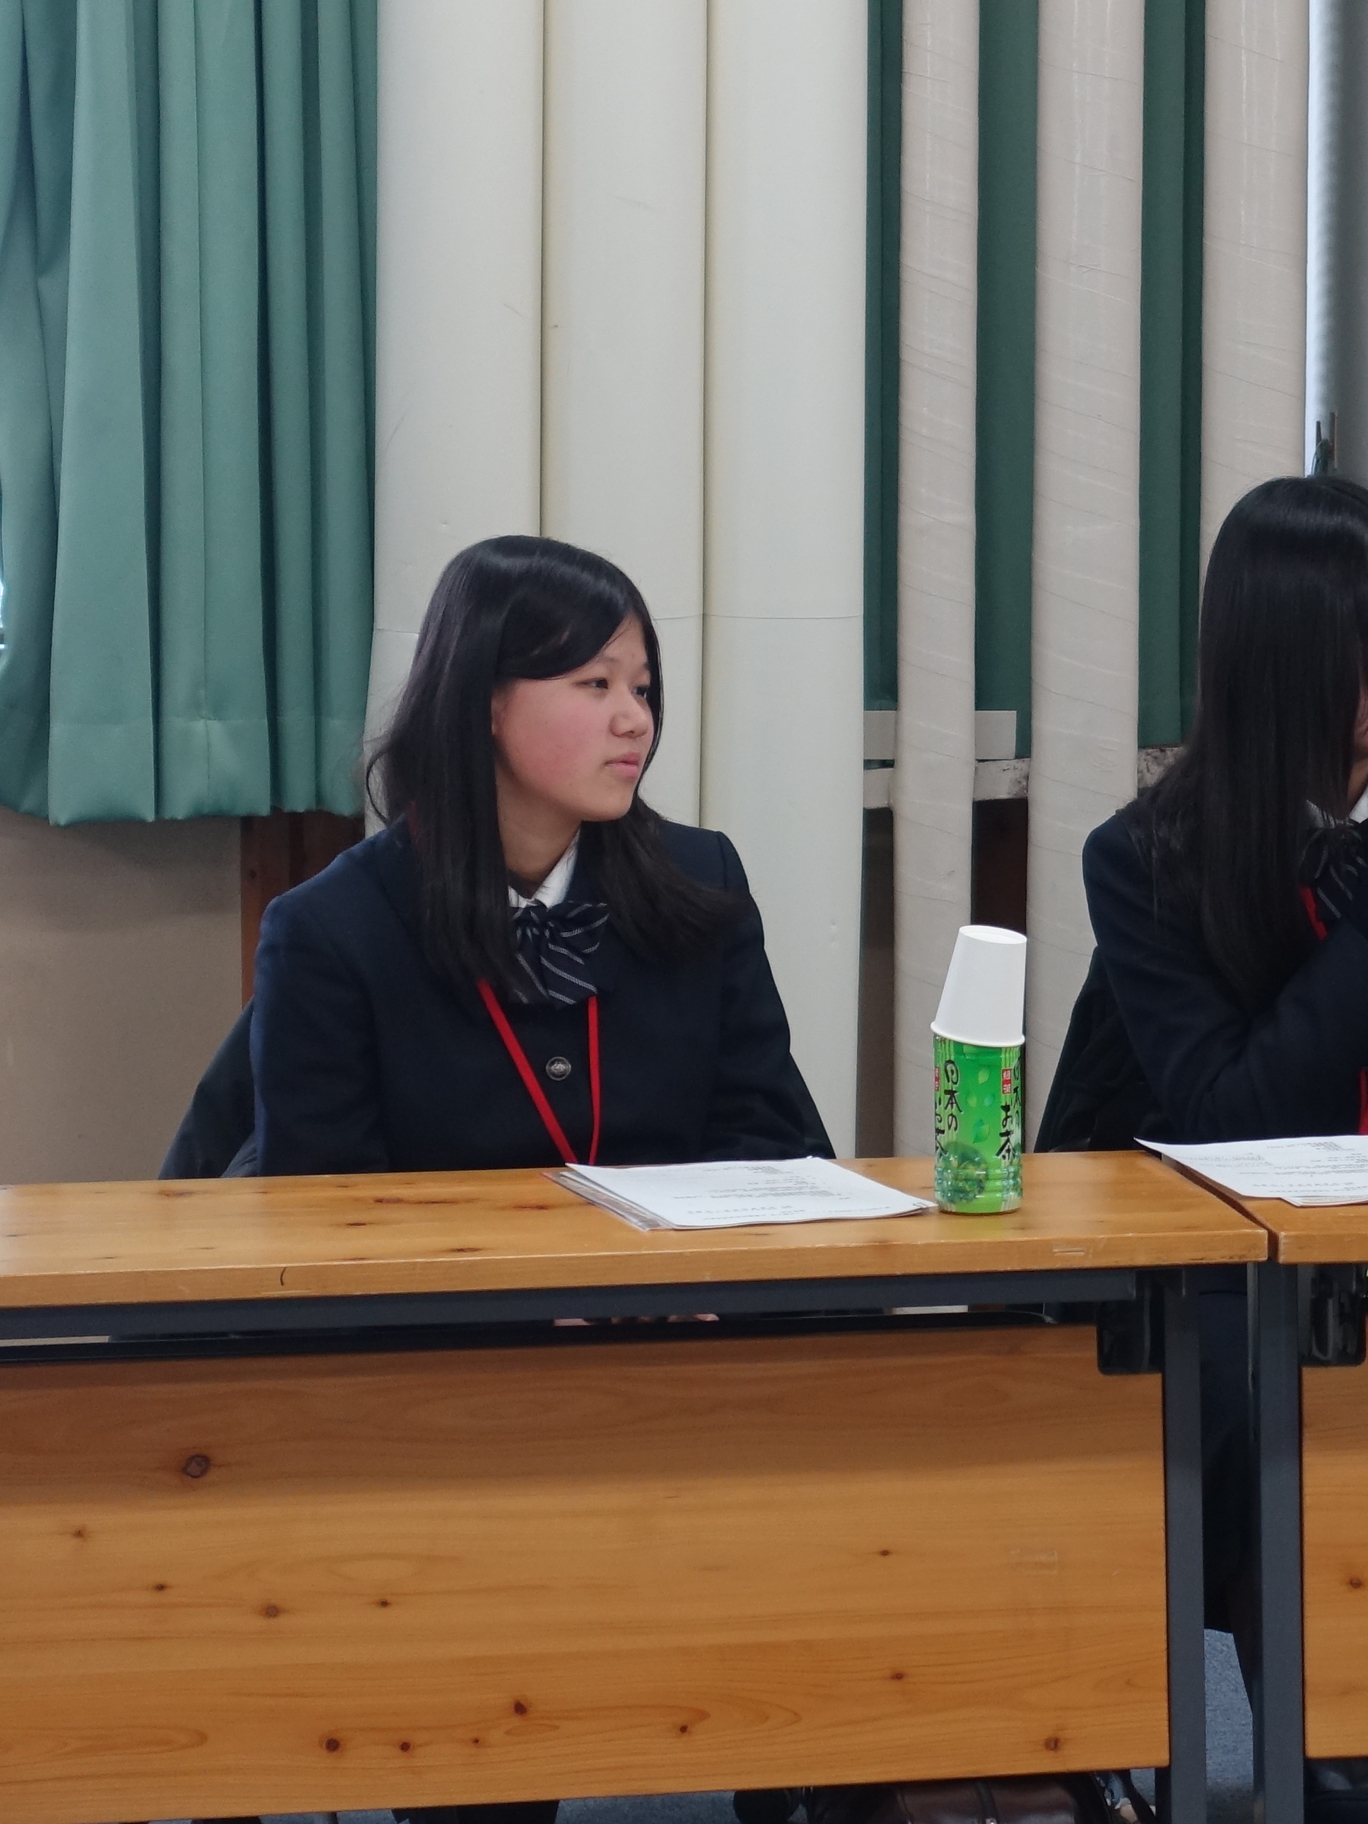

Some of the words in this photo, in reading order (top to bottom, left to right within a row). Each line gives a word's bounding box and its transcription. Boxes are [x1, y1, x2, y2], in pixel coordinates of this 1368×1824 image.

[944, 1060, 963, 1132] 日本の
[995, 1098, 1016, 1161] お茶
